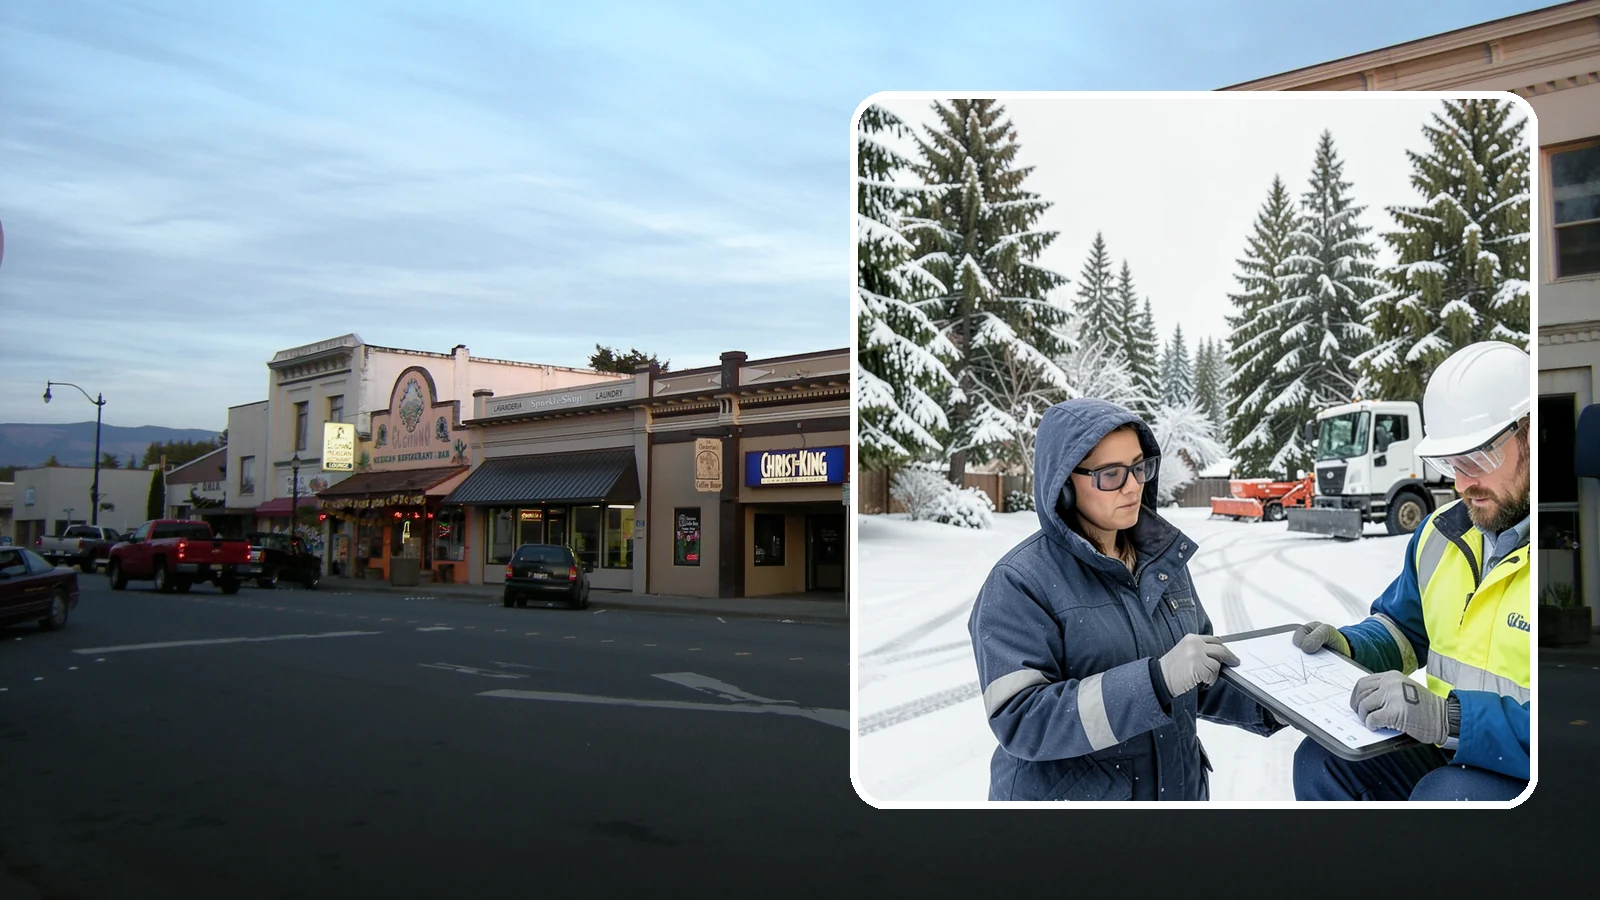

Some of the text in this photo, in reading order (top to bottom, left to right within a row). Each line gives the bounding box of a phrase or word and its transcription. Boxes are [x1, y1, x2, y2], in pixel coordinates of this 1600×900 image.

[596, 389, 623, 399] LAUNDRY
[493, 402, 522, 412] LAVANDERIA
[373, 455, 396, 464] MEXICAN
[397, 451, 434, 462] RESTAURANT
[437, 450, 450, 459] BAR
[799, 450, 827, 476] KING
